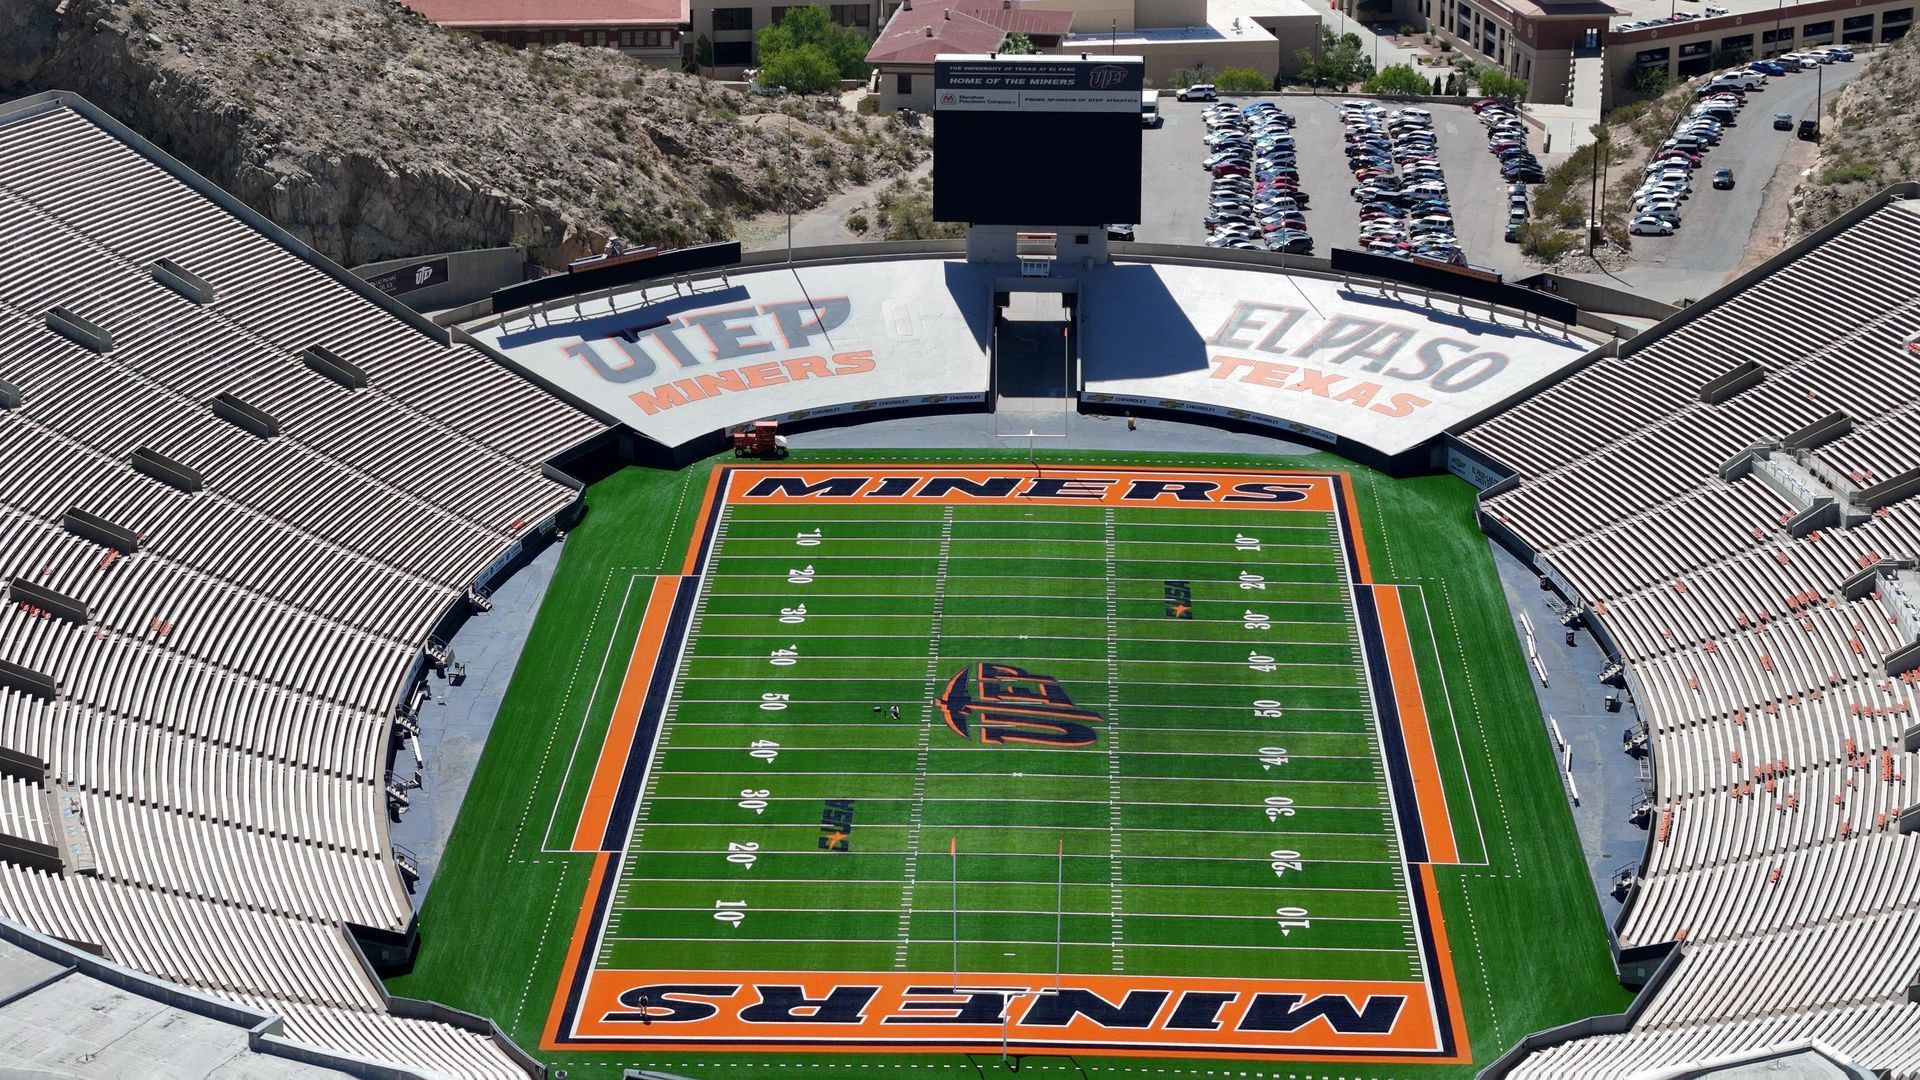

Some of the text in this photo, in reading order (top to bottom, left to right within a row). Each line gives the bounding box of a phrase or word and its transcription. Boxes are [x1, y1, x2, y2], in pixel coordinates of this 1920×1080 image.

[415, 266, 433, 285] UTEP
[559, 296, 851, 384] UTEP
[1207, 300, 1511, 393] EL PASO
[628, 350, 877, 416] MINERS
[1209, 355, 1432, 417] TEXAS
[1185, 404, 1216, 412] CHEVROLET
[742, 476, 1317, 503] MINERS
[796, 531, 822, 546] 10
[1235, 537, 1261, 551] 10
[788, 569, 815, 583] 20
[1239, 574, 1266, 590] 20
[779, 607, 807, 623] 30
[1244, 614, 1271, 630] 30
[769, 649, 798, 665] 40
[1248, 656, 1277, 672] 40
[760, 693, 790, 710] 50
[934, 662, 1104, 747] UTEP
[1253, 700, 1282, 717] 50
[750, 740, 780, 758] 40
[1258, 747, 1289, 765] 40
[738, 789, 770, 808] 30
[1264, 797, 1295, 816] 30
[726, 841, 759, 863] 20
[1270, 850, 1302, 871] 20
[713, 900, 747, 921] 10
[1276, 907, 1310, 928] 10
[598, 984, 1409, 1036] MINERS
